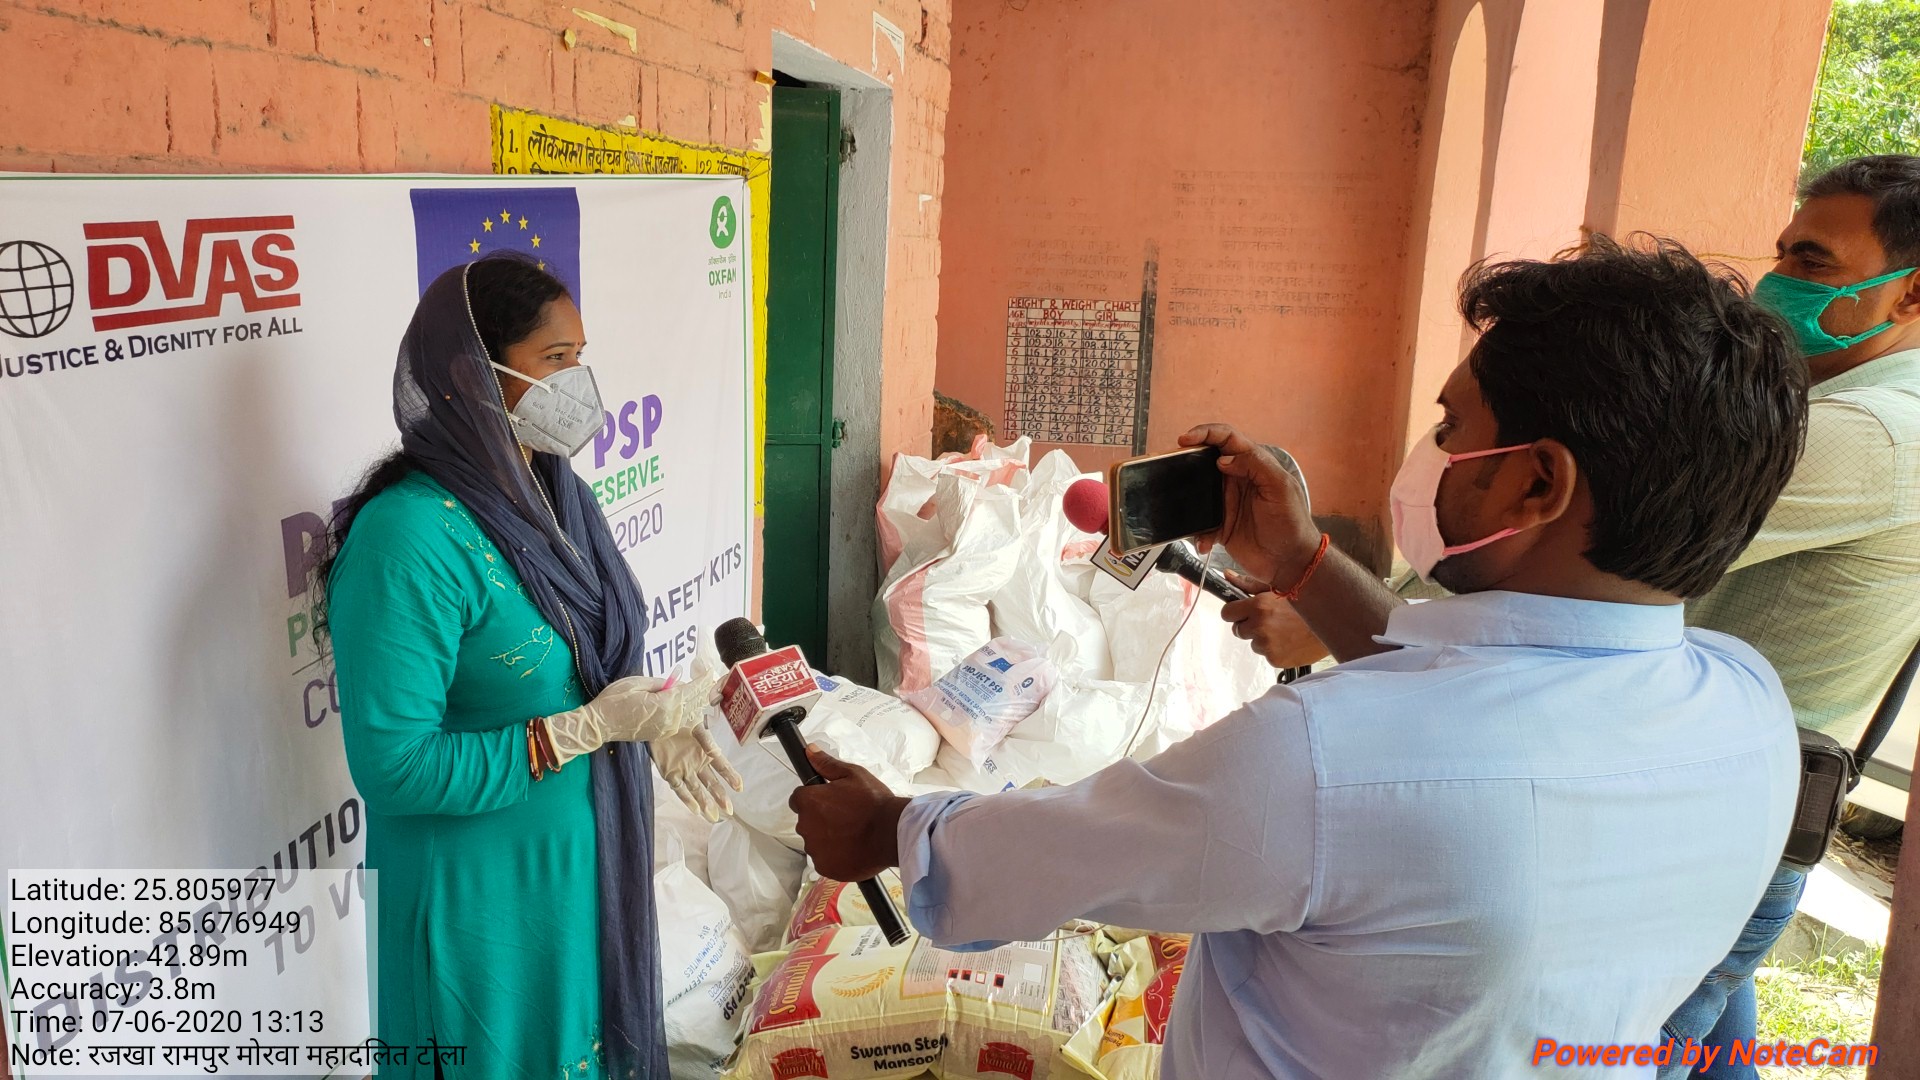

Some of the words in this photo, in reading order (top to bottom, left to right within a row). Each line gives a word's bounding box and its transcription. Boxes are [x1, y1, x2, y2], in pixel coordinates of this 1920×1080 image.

[83, 215, 301, 332] DVAS
[1011, 299, 1045, 309] HEIGHT
[1050, 299, 1058, 309] &
[1062, 299, 1098, 310] WEIGHT
[1104, 301, 1139, 312] CHART
[1043, 308, 1064, 319] BOY
[1095, 310, 1118, 321] GIRL
[105, 339, 124, 362] &
[128, 328, 217, 359] DIGNITY
[223, 322, 263, 344] FOR
[267, 316, 303, 336] ALL
[1116, 331, 1126, 340] 16
[1011, 337, 1021, 347] 5
[1011, 356, 1019, 364] 7
[1010, 384, 1019, 392] 10
[1010, 393, 1017, 402] 11
[1008, 403, 1017, 412] 12
[1007, 411, 1017, 420] 13
[594, 394, 663, 470] PSP
[1006, 420, 1017, 430] 14
[1052, 422, 1069, 432] 47
[1005, 431, 1017, 440] 15
[615, 503, 664, 553] 2020
[709, 542, 742, 587] KITS
[772, 664, 794, 676] NEWS
[753, 671, 798, 694] इंडिया
[989, 681, 1003, 694] PSP
[850, 1042, 912, 1060] Swarna
